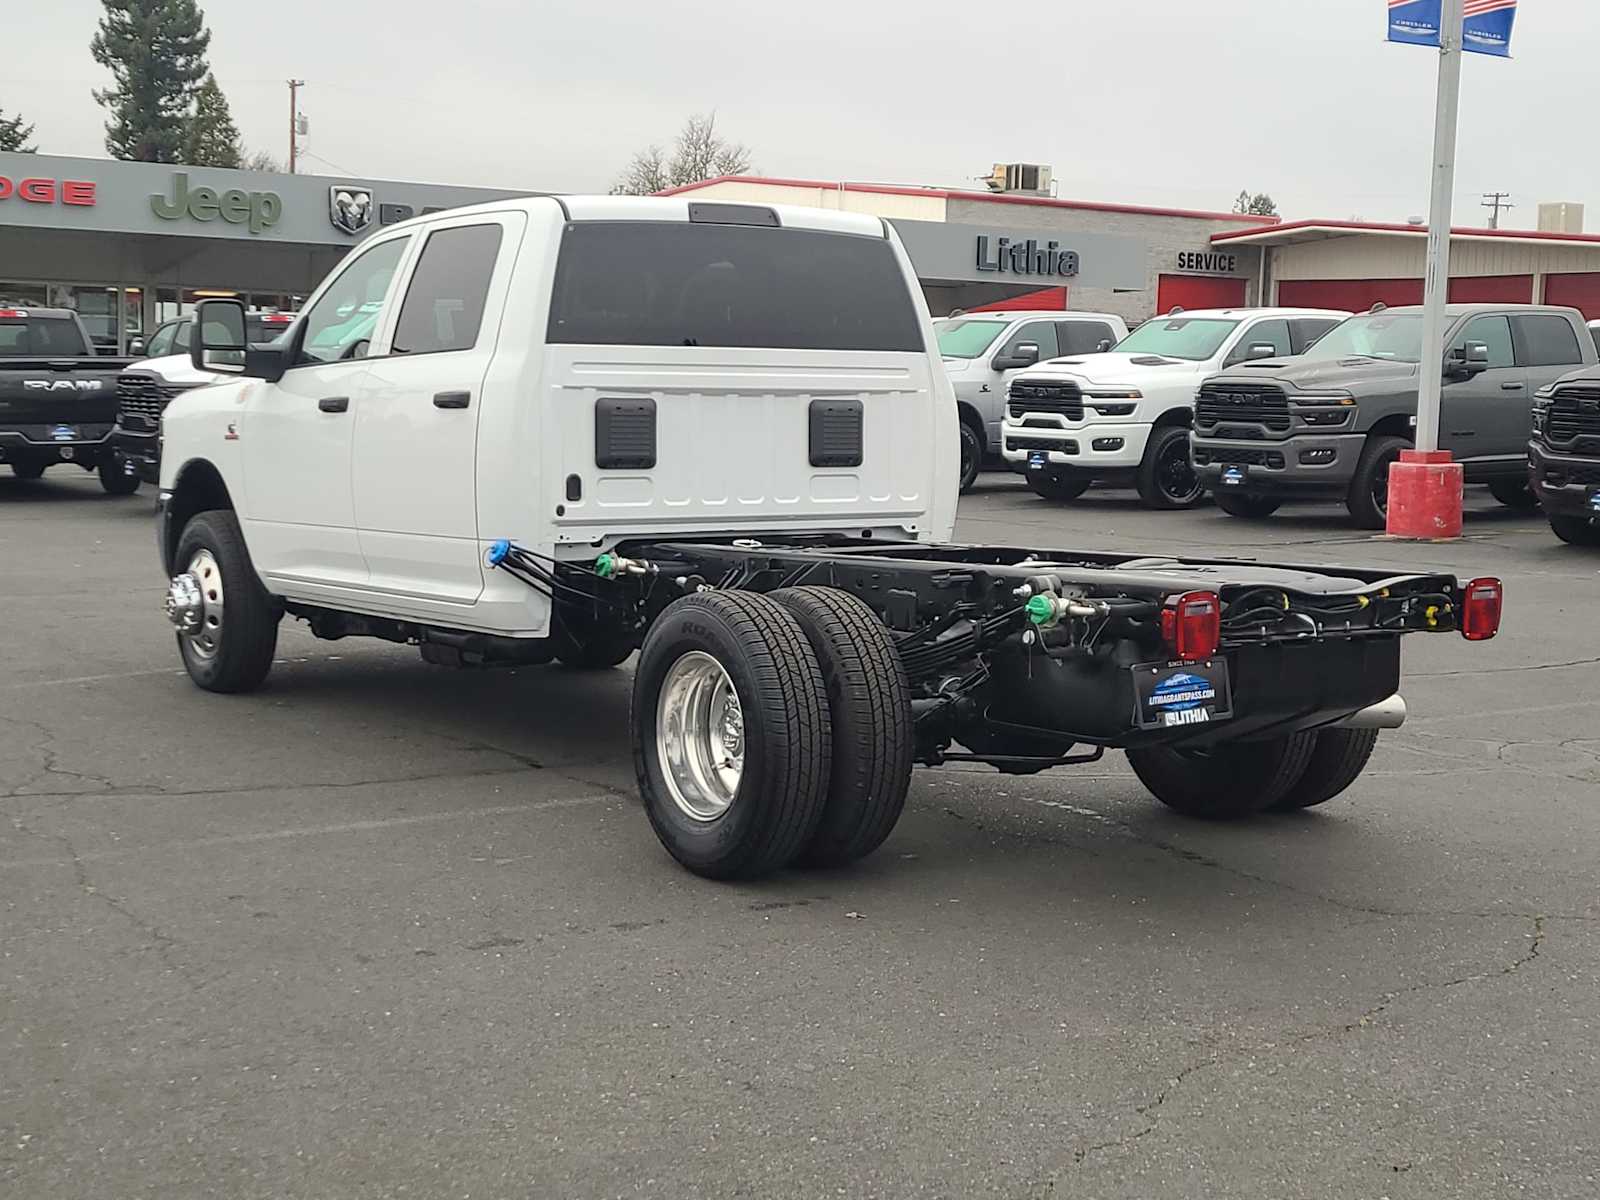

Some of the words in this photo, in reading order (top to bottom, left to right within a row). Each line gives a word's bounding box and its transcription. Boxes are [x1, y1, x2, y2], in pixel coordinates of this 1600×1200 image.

[149, 171, 282, 234] Jeep
[976, 234, 1080, 277] Lithia
[1178, 251, 1236, 272] SERVICE
[23, 380, 102, 391] RAM
[1175, 708, 1210, 725] LITHIA
